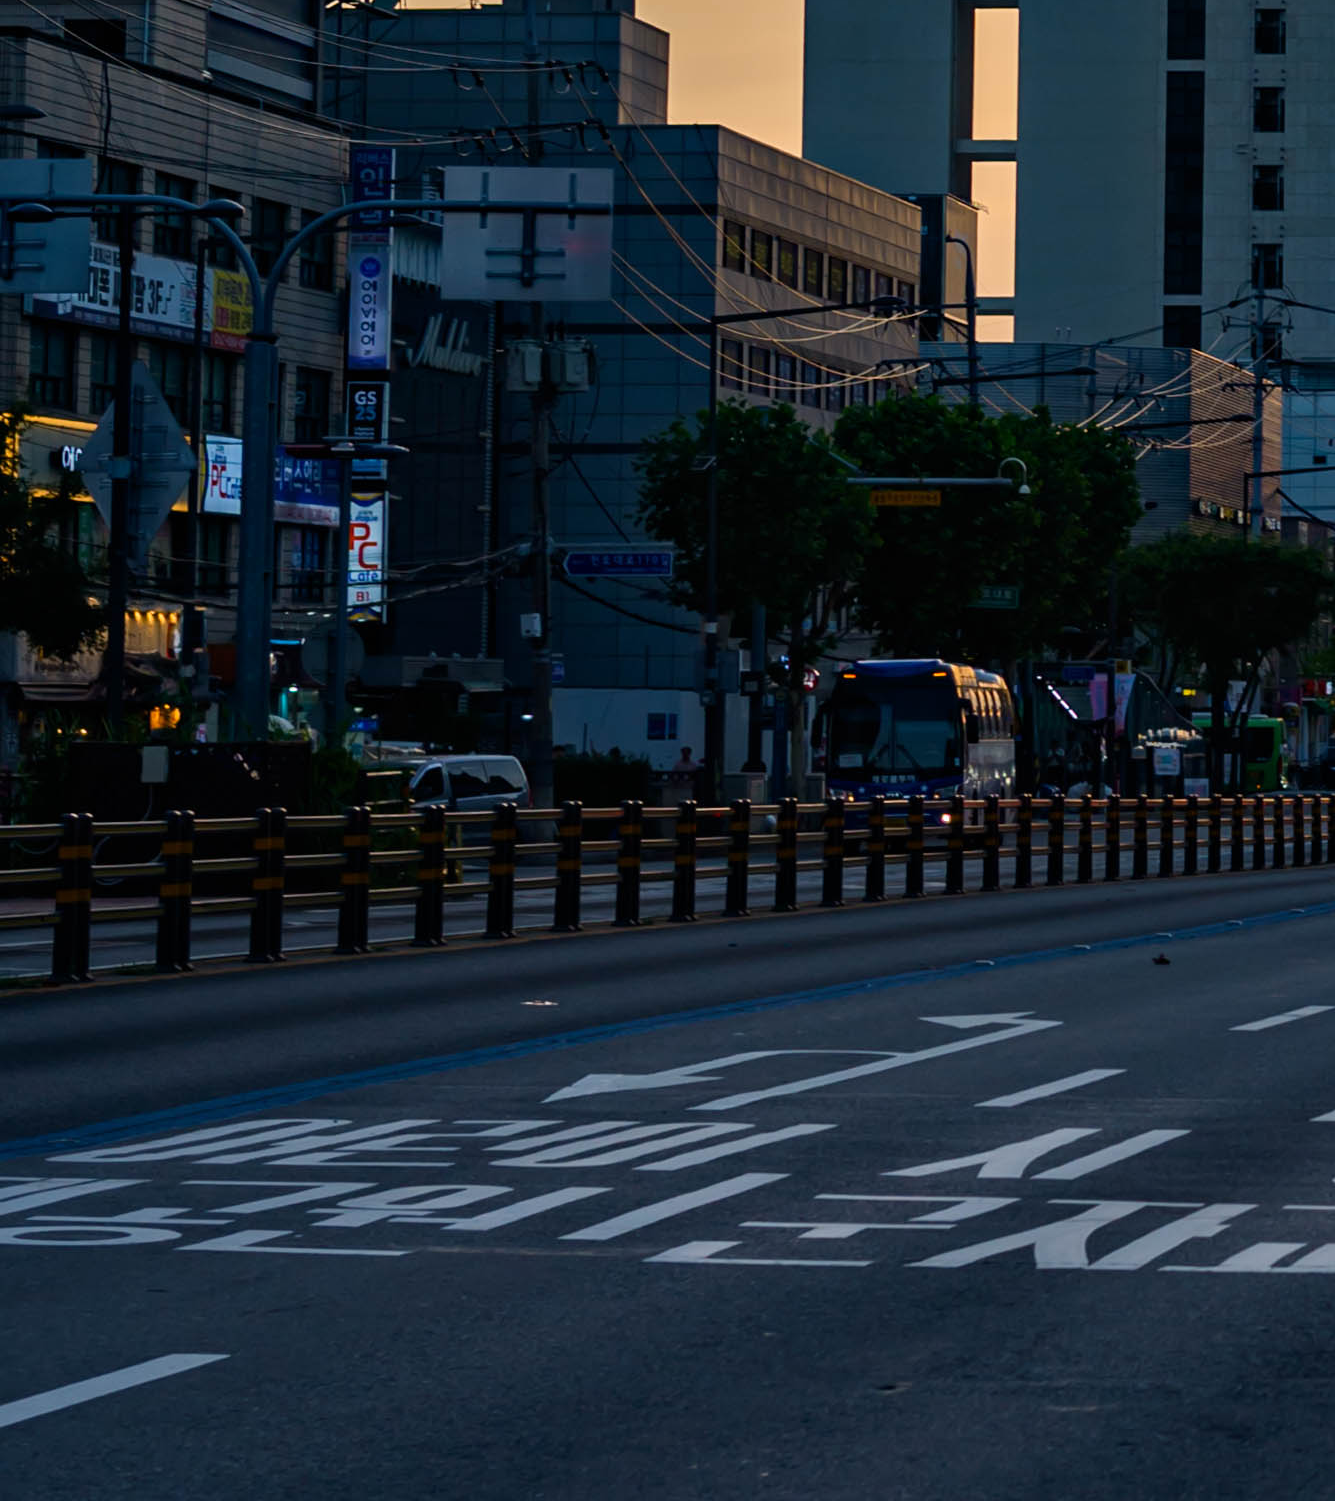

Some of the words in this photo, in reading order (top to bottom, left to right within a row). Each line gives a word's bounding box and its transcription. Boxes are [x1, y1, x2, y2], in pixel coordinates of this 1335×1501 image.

[354, 390, 378, 405] GS
[354, 405, 378, 422] 25
[348, 523, 379, 569] PC
[45, 1118, 838, 1172] 어린이
